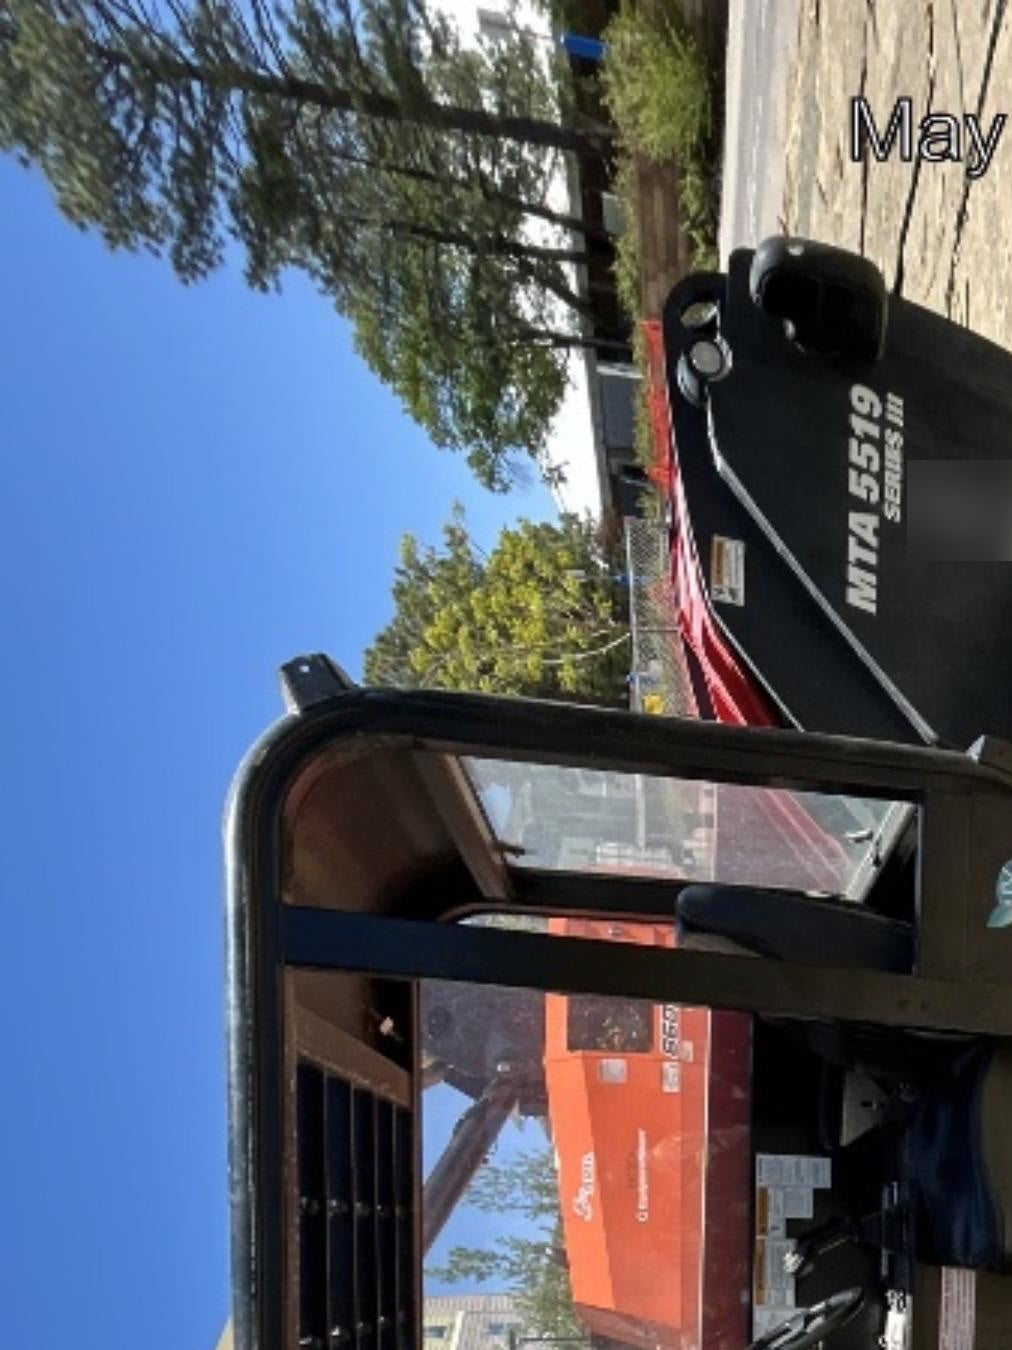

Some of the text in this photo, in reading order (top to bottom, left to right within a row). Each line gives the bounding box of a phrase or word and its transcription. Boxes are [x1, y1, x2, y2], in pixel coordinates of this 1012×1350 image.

[846, 383, 882, 613] MTA 5519
[884, 394, 903, 522] SERIES III
